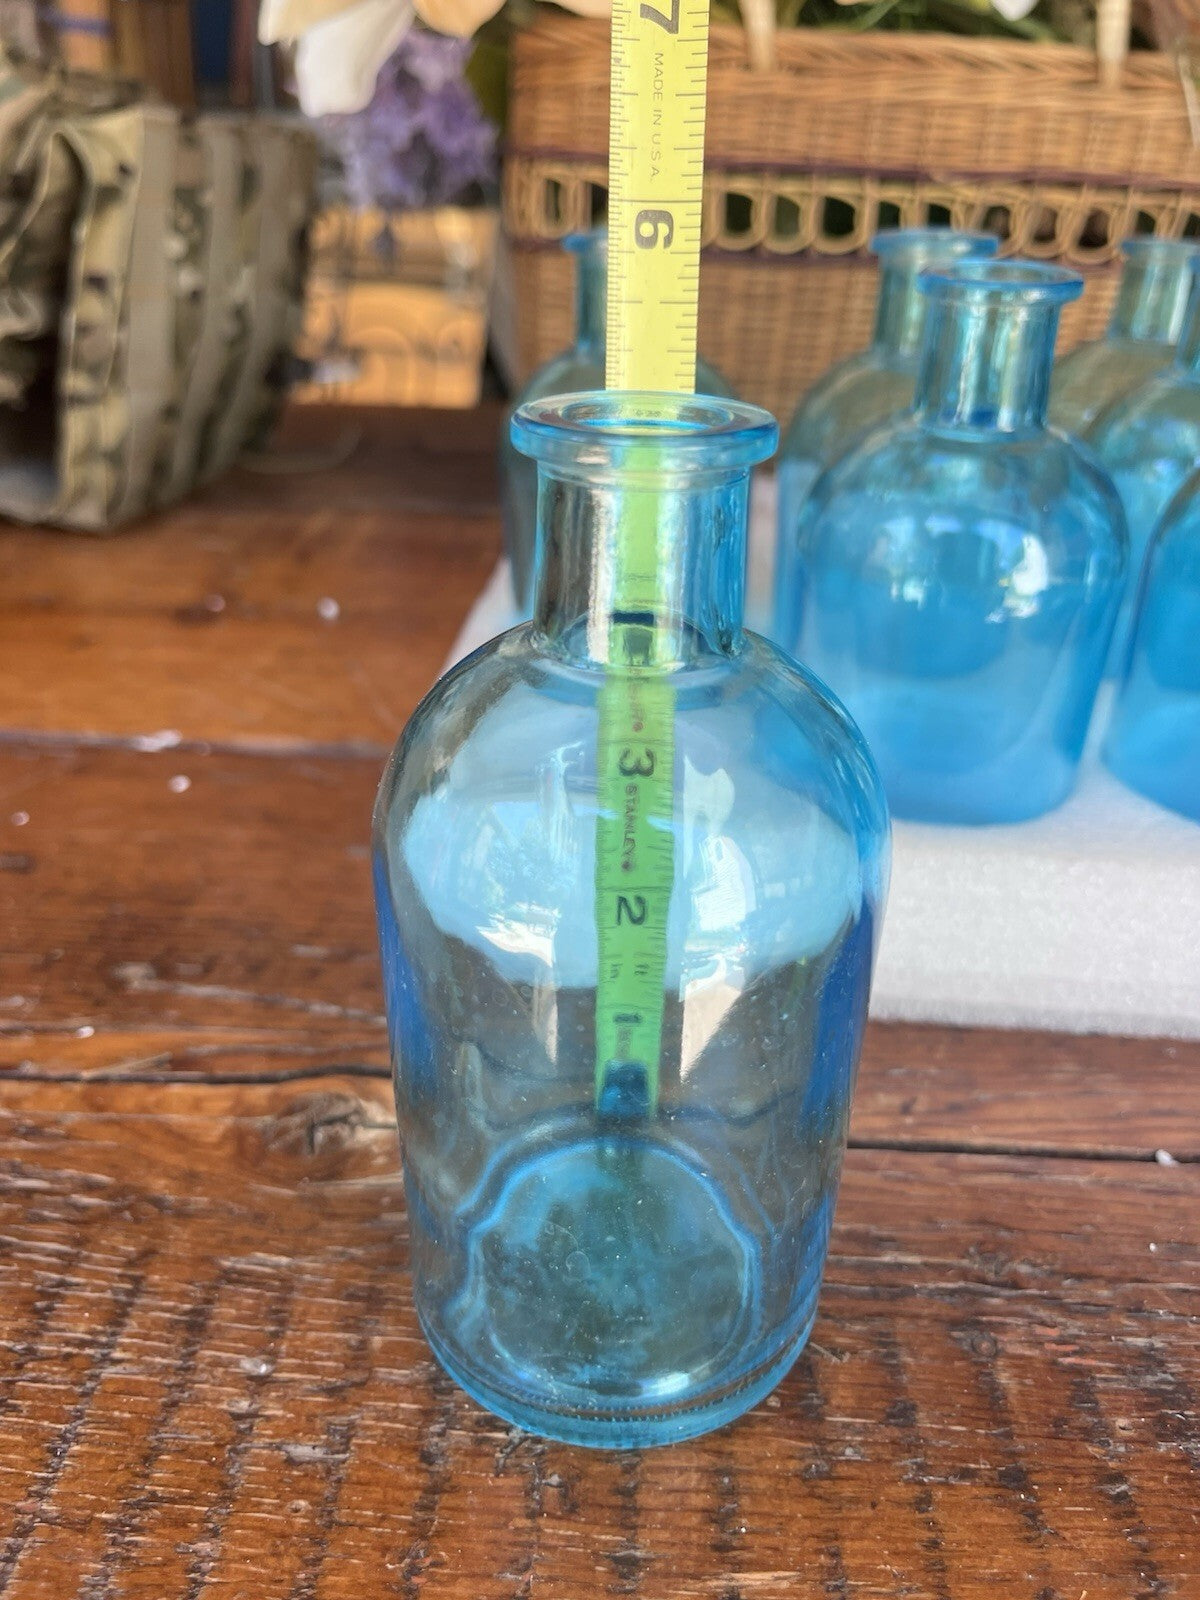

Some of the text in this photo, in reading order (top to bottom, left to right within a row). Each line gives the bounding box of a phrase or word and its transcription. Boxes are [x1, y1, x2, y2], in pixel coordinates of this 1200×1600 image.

[639, 0, 681, 35] 7
[652, 52, 664, 102] MADE
[652, 109, 662, 126] IN
[634, 209, 675, 250] 6
[618, 748, 656, 778] 3
[616, 895, 647, 926] 2
